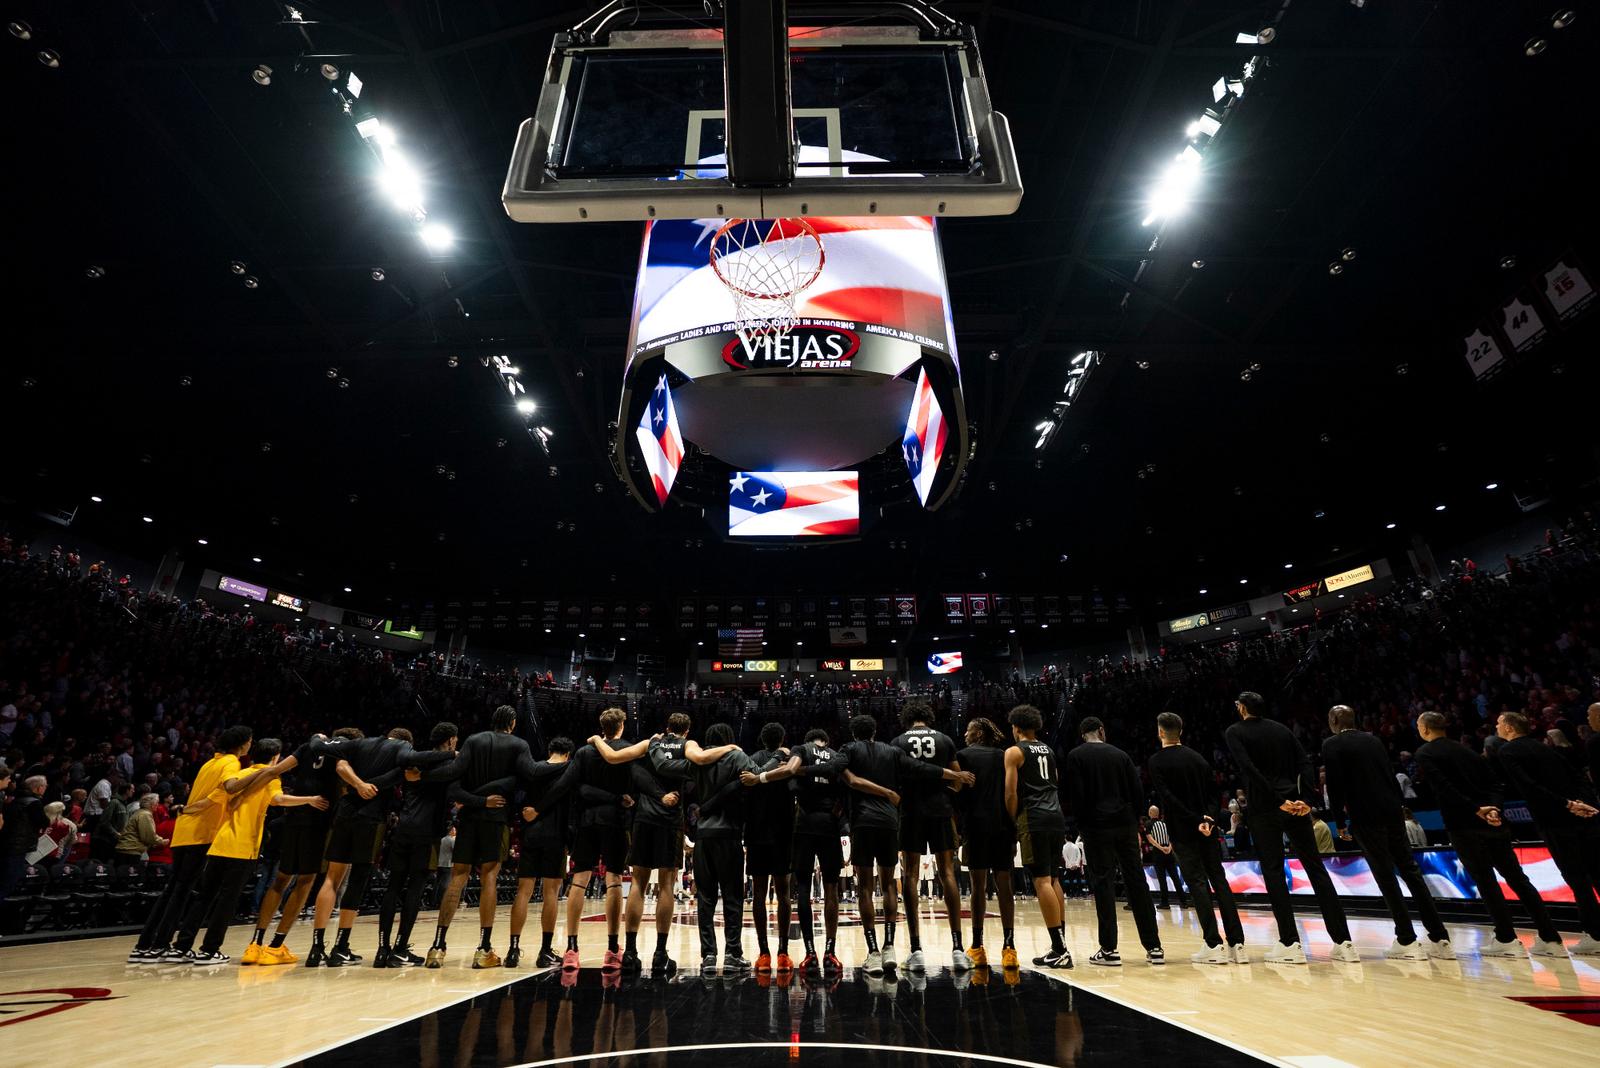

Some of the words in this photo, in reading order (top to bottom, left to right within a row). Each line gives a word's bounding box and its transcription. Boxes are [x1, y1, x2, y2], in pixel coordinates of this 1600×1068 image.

[1512, 310, 1529, 330] 44
[680, 328, 704, 340] LADIES
[704, 325, 721, 336] AND
[813, 319, 855, 330] HONORING
[865, 324, 899, 338] AMERICA
[899, 331, 915, 341] AND
[915, 335, 944, 351] CELEBRAT
[737, 331, 842, 368] VIEJAS
[1470, 341, 1492, 362] 22
[800, 360, 852, 368] arena
[746, 660, 777, 671] COX
[908, 736, 936, 759] 33
[1028, 744, 1050, 754] SYKES
[1037, 755, 1050, 780] 11
